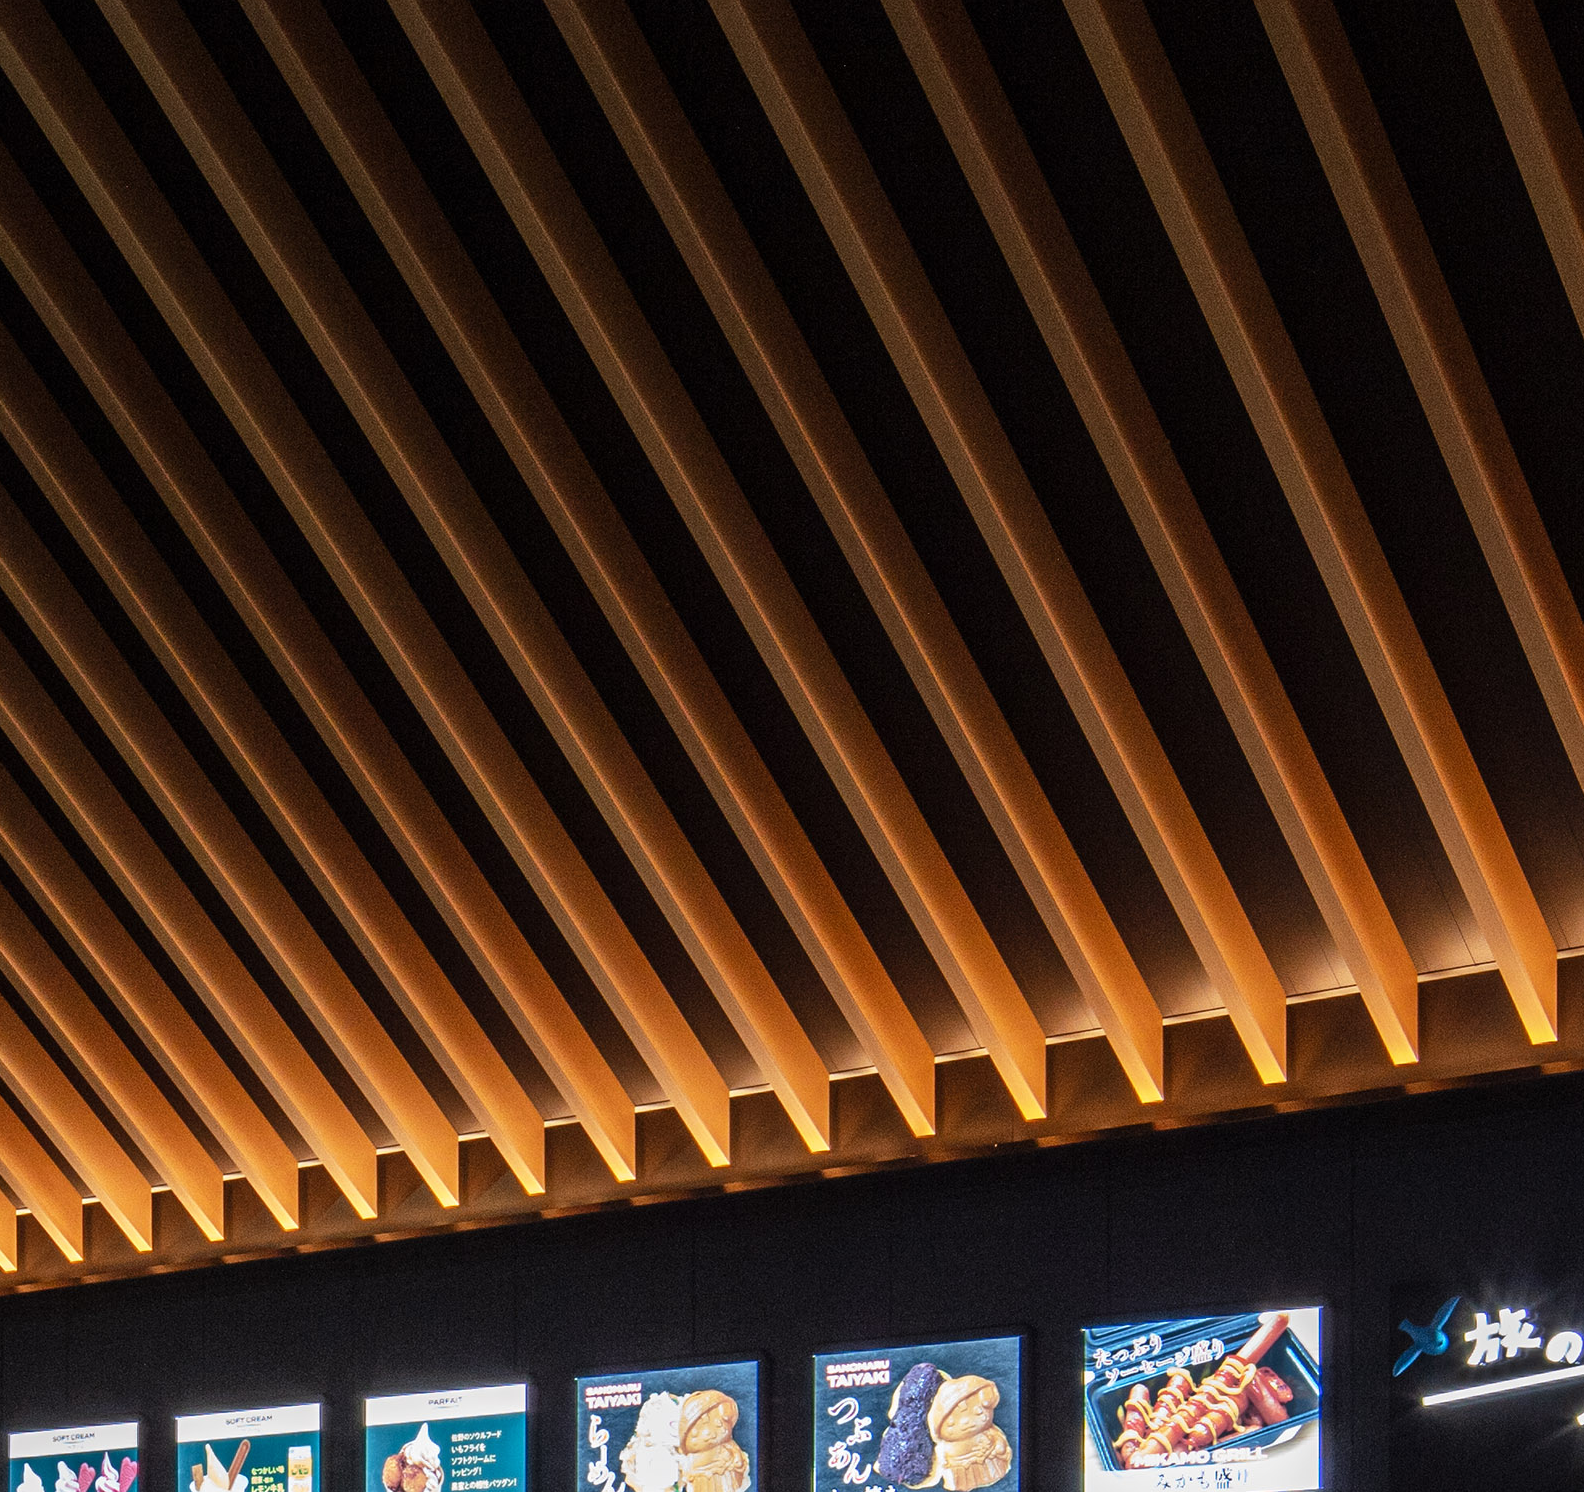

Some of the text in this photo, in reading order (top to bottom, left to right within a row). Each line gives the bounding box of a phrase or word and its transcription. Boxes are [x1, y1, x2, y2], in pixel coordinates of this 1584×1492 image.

[1464, 1307, 1584, 1366] 旅の
[1093, 1334, 1163, 1368] たっぷり
[1106, 1338, 1225, 1386] ソーセージ盛り
[826, 1370, 890, 1388] TAIYAKI
[428, 1397, 462, 1405] PARFAIT
[586, 1393, 642, 1409] TAIYAKI
[225, 1415, 273, 1425] SOFT CREAM
[828, 1397, 872, 1484] つぶあん
[1131, 1450, 1210, 1467] MIKAMO
